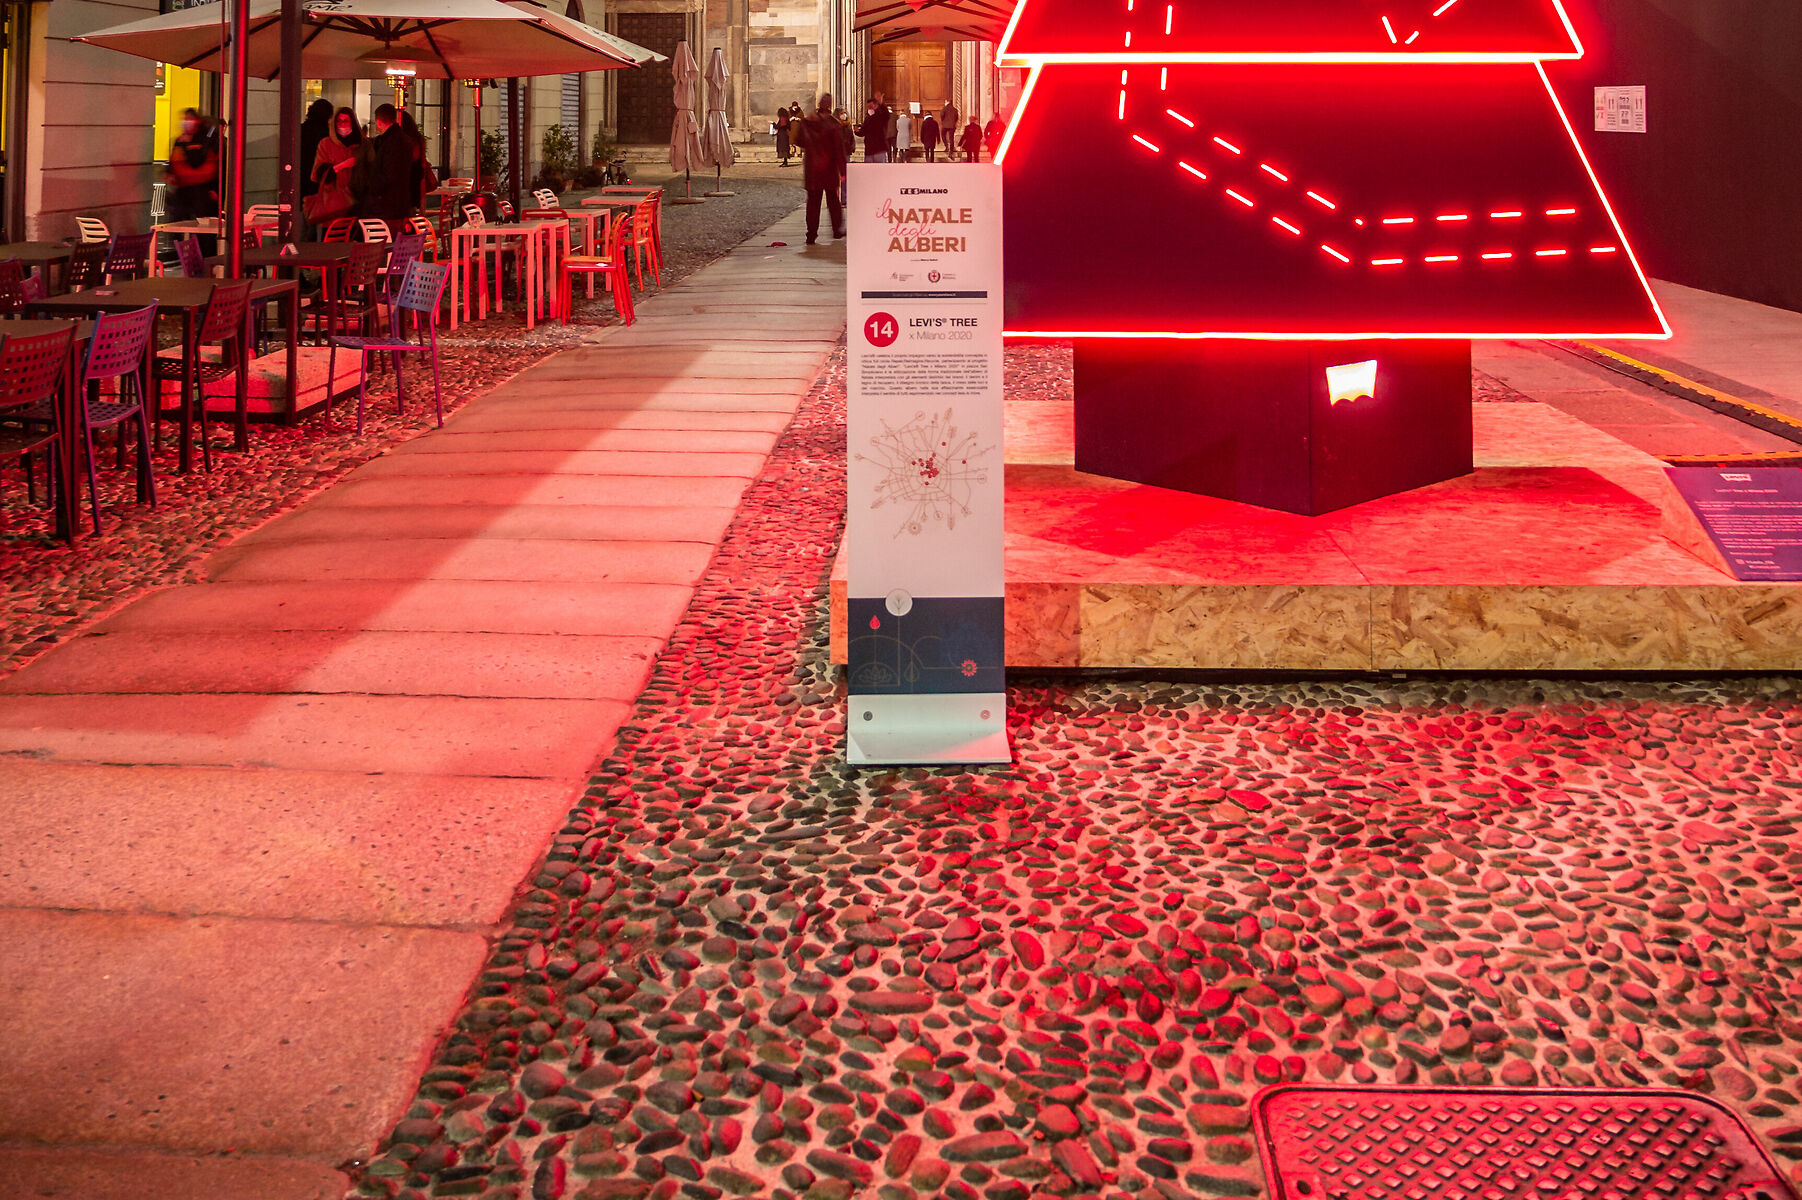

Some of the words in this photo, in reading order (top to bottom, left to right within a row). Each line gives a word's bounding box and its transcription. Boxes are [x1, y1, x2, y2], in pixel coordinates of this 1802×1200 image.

[876, 198, 892, 219] il
[888, 208, 973, 224] NATALE
[888, 216, 937, 249] degli
[888, 237, 966, 253] ALBERI
[870, 321, 894, 338] 14
[950, 318, 978, 327] TREE
[916, 331, 946, 340] Milano
[948, 331, 973, 340] 2020
